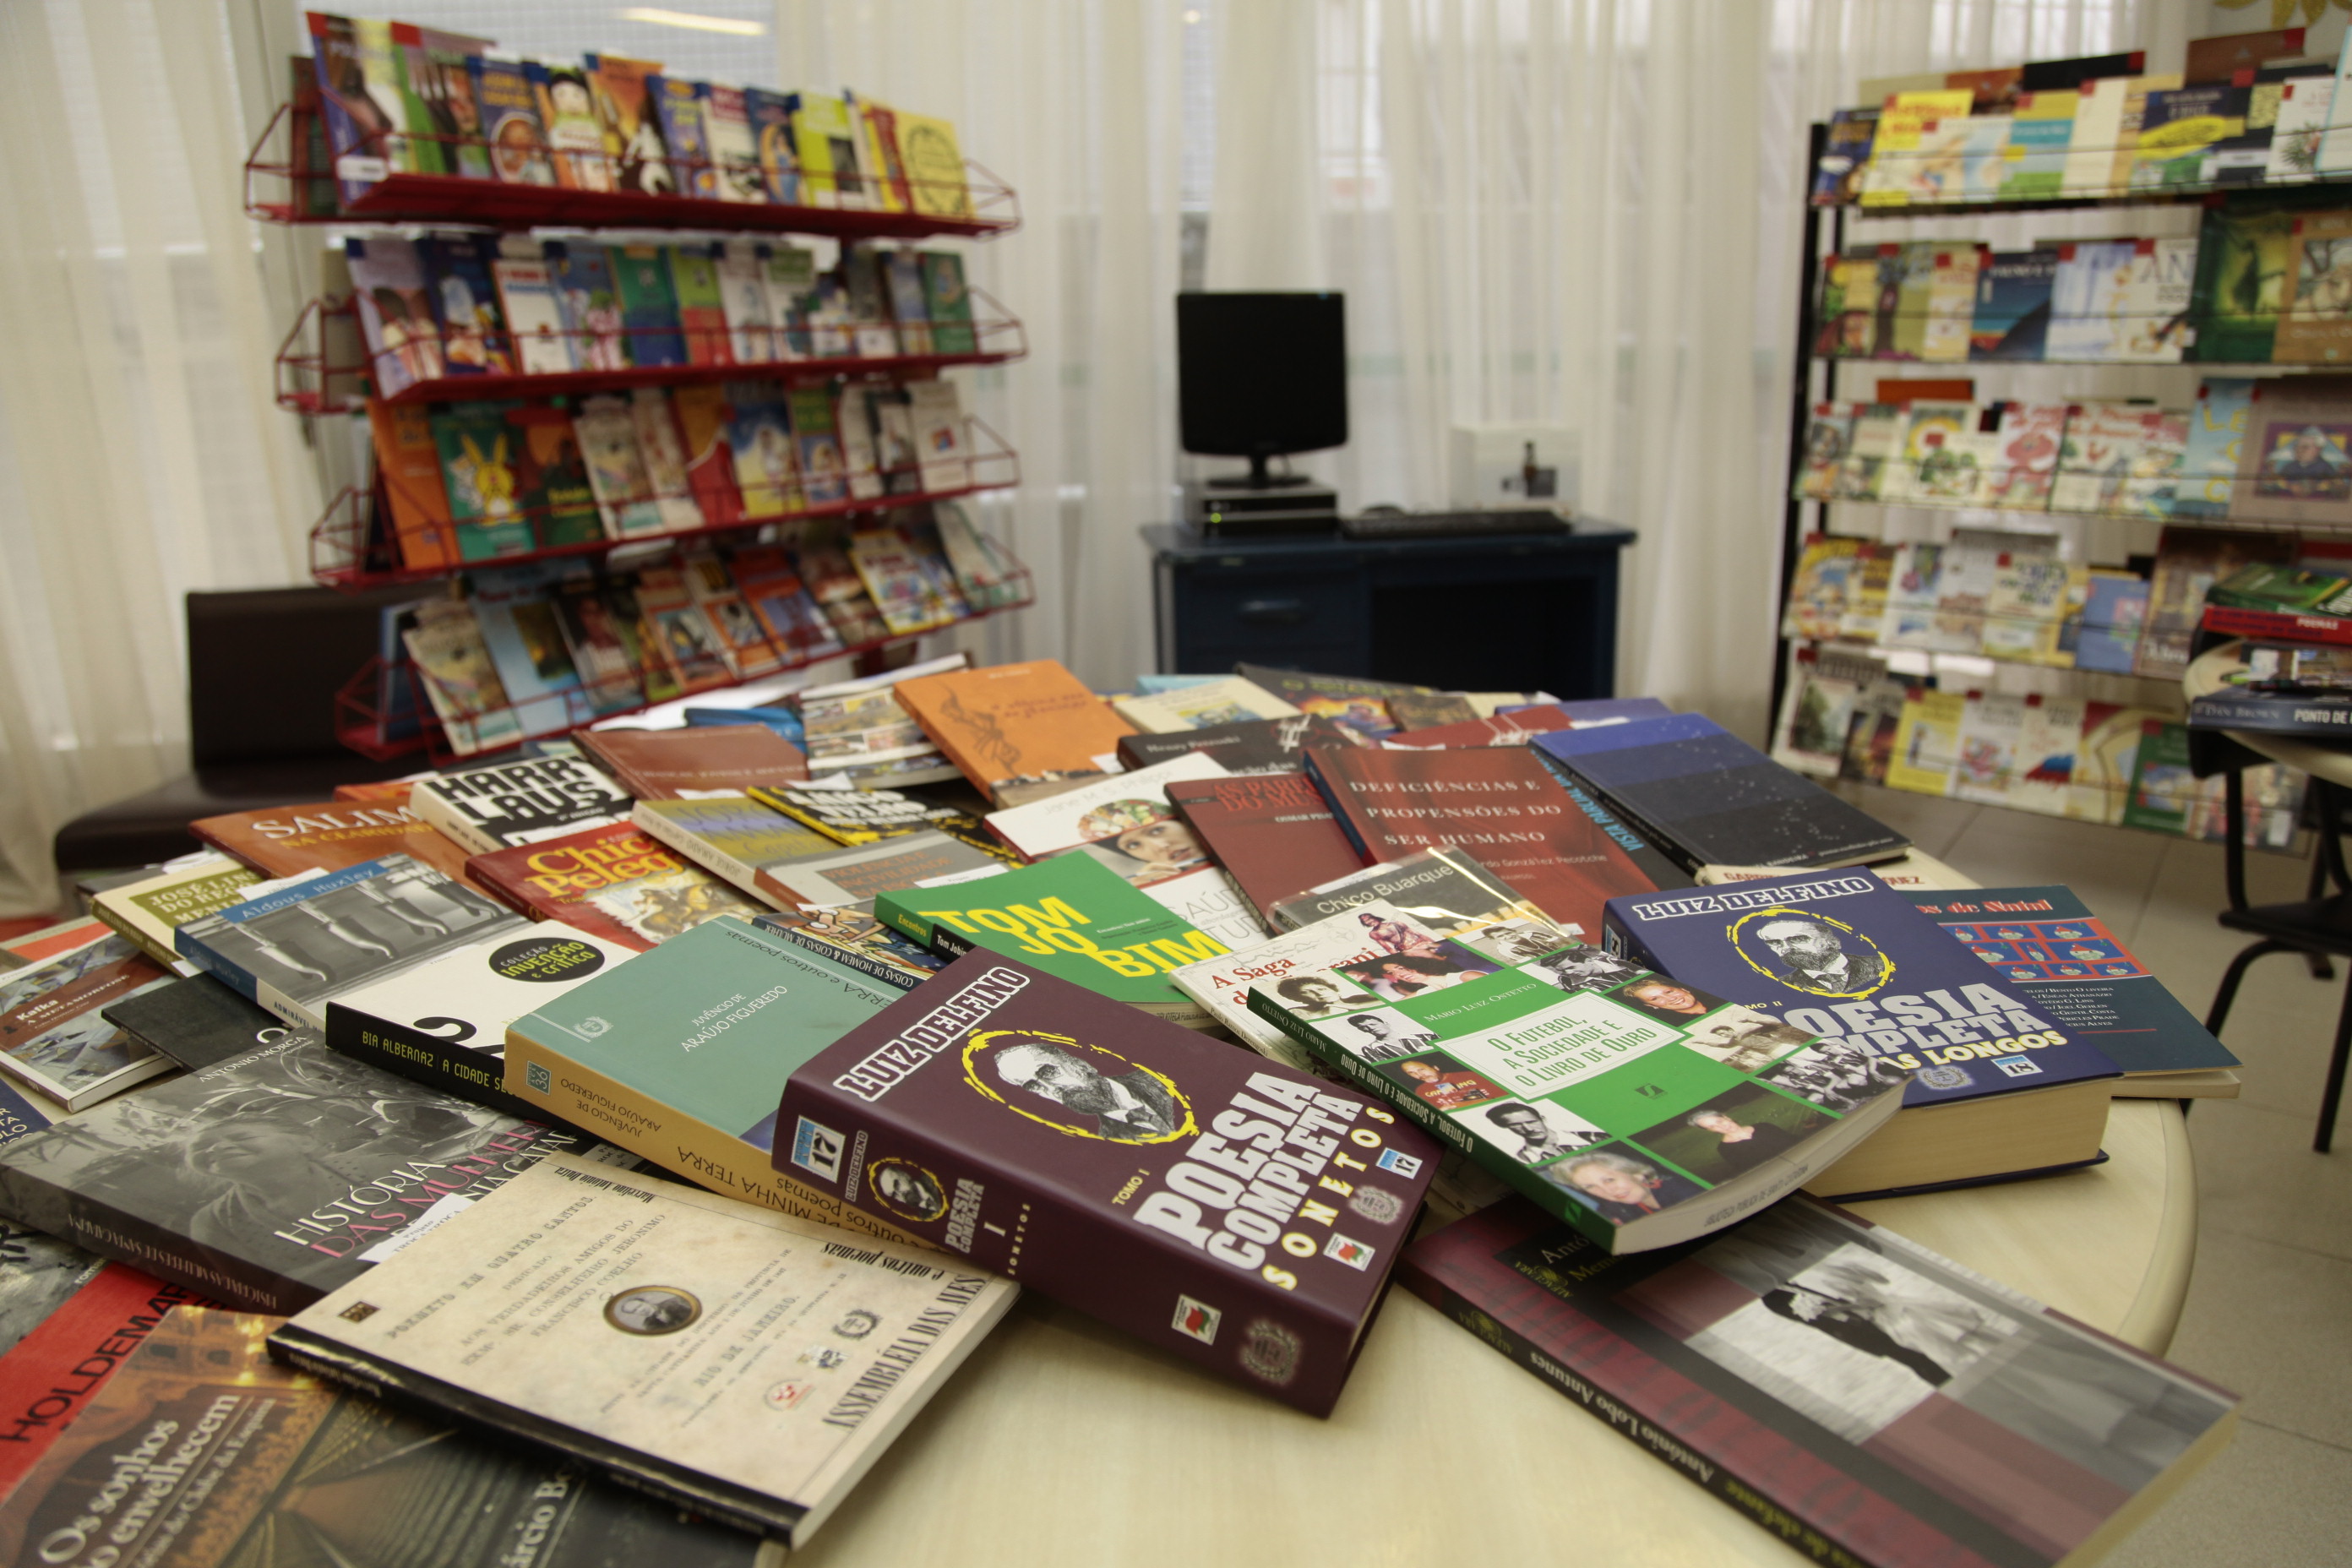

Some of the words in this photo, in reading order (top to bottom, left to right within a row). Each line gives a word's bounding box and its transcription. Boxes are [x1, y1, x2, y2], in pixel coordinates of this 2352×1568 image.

[2295, 708, 2330, 723] PONTO
[424, 754, 589, 802] HARR
[1350, 778, 1518, 794] DEFICIÊNCIAS
[1525, 780, 1542, 792] E
[1366, 803, 1522, 819] PROPENSÕES
[1527, 804, 1561, 816] DO
[1384, 833, 1432, 846] SER
[1440, 830, 1547, 846] HUMANO
[148, 882, 204, 906] JOSÉ
[158, 900, 193, 913] DO
[242, 892, 306, 919] Aldous
[313, 868, 375, 893] Huxley
[1316, 893, 1375, 917] Chico
[1375, 863, 1455, 899] Buarque
[1631, 896, 1723, 922] LUIZ
[1718, 875, 1876, 912] DELFINO
[1946, 901, 1981, 915] de
[1982, 898, 2054, 913] Natal
[898, 913, 928, 938] Encontros
[937, 934, 950, 948] Tom
[917, 896, 1092, 935] TOM
[500, 945, 549, 967] COLEÇÃO
[726, 928, 782, 958] poemas
[805, 940, 832, 956] COISAS
[1019, 928, 1099, 956] JO
[1090, 929, 1233, 977] BIM
[781, 954, 828, 979] outros
[841, 954, 873, 972] HOMEM
[873, 965, 885, 976] DE
[884, 969, 914, 988] COISAS
[1211, 973, 1236, 989] A
[1233, 956, 1297, 983] Saga
[17, 999, 59, 1021] Kafka
[681, 1017, 729, 1053] ARAÚJO
[727, 984, 788, 1026] FIGUEREDO
[690, 997, 734, 1027] JUVÊNCIO
[732, 992, 747, 1003] DE
[1261, 1003, 1289, 1026] OSTETTO
[1423, 1008, 1462, 1022] MARIO
[1461, 999, 1489, 1012] LUIZ
[1488, 983, 1538, 1003] OSTETTO
[1772, 999, 1783, 1008] II
[832, 1038, 933, 1102] LUIZ
[900, 966, 1032, 1054] DELFINO
[1211, 1007, 1225, 1022] Paulo
[1224, 1018, 1241, 1034] Ramos
[1290, 1022, 1305, 1037] LUIZ
[1487, 1037, 1514, 1053] O
[1505, 1014, 1588, 1044] FUTEBOL,
[199, 1055, 259, 1083] ANTONIO
[259, 1035, 307, 1059] MORGA
[362, 1031, 379, 1048] BIA
[383, 1037, 434, 1067] ALBERNAZ
[454, 1062, 491, 1088] CIDADE
[1308, 1032, 1327, 1053] MARIO
[1503, 1057, 1521, 1070] A
[1513, 1025, 1609, 1064] SOCIEDADE
[1604, 1019, 1624, 1032] E
[1514, 1075, 1537, 1088] O
[1529, 1056, 1587, 1082] LIVRO
[1586, 1047, 1611, 1064] DE
[1600, 1026, 1658, 1054] OURO
[1922, 1029, 2069, 1066] LONGOS
[535, 1070, 548, 1090] 36
[1340, 1054, 1358, 1076] OURO
[1357, 1064, 1367, 1078] DE
[1366, 1069, 1385, 1095] LIVRO
[2007, 1061, 2035, 1076] 18
[560, 1077, 618, 1117] FIGUEREDO
[575, 1099, 590, 1113] DE
[1396, 1090, 1430, 1124] SOCIEDADE
[591, 1107, 642, 1138] JUVÊNCIO
[617, 1106, 662, 1134] ARAÚJO
[1437, 1113, 1468, 1149] FUTEBOL,
[812, 1132, 837, 1172] 17
[849, 1130, 868, 1178] DELFINO
[1132, 1070, 1323, 1252] POESIA
[1467, 1137, 1475, 1153] O
[1206, 1092, 1364, 1271] COMPLETA
[1395, 1155, 1417, 1174] 17
[612, 1183, 656, 1205] Marcelino
[677, 1146, 737, 1188] TERRA
[740, 1175, 811, 1219] MINHA
[776, 1178, 842, 1217] poemas
[845, 1175, 859, 1203] LUIZ
[1112, 1175, 1144, 1207] TOMO
[1261, 1105, 1396, 1293] SONETOS
[274, 1161, 447, 1246] HISTÓRIA
[945, 1178, 975, 1248] POESIA
[958, 1182, 986, 1255] COMPLETA
[310, 1208, 407, 1258] DAS
[847, 1211, 901, 1243] outros
[983, 1221, 1007, 1238] I
[1006, 1202, 1032, 1276] SONETOS
[528, 1257, 610, 1320] CONSELHEIRO
[612, 1212, 667, 1257] JERONIMO
[819, 1242, 879, 1266] poemas
[879, 1255, 931, 1280] outros
[387, 1293, 456, 1340] POEMETO
[460, 1272, 486, 1291] EM
[487, 1232, 543, 1271] QUATRO
[460, 1329, 487, 1349] AOS
[487, 1265, 571, 1329] VERDADEIROS
[574, 1233, 616, 1266] AMIGOS
[615, 1217, 634, 1234] DO
[530, 1288, 598, 1339] FRANCISCO
[596, 1250, 645, 1288] COELHO
[693, 1365, 723, 1388] RIO
[721, 1344, 745, 1364] DE
[821, 1337, 929, 1433] ASSEMBLÉIA
[906, 1308, 948, 1341] DAS
[935, 1274, 988, 1319] AVES
[1529, 1352, 1596, 1406] Antunes
[1596, 1396, 1640, 1437] Lobo
[109, 1394, 242, 1544] envelhecem
[1639, 1424, 1715, 1484] António
[38, 1515, 102, 1563] Os
[89, 1419, 179, 1514] sonhos
